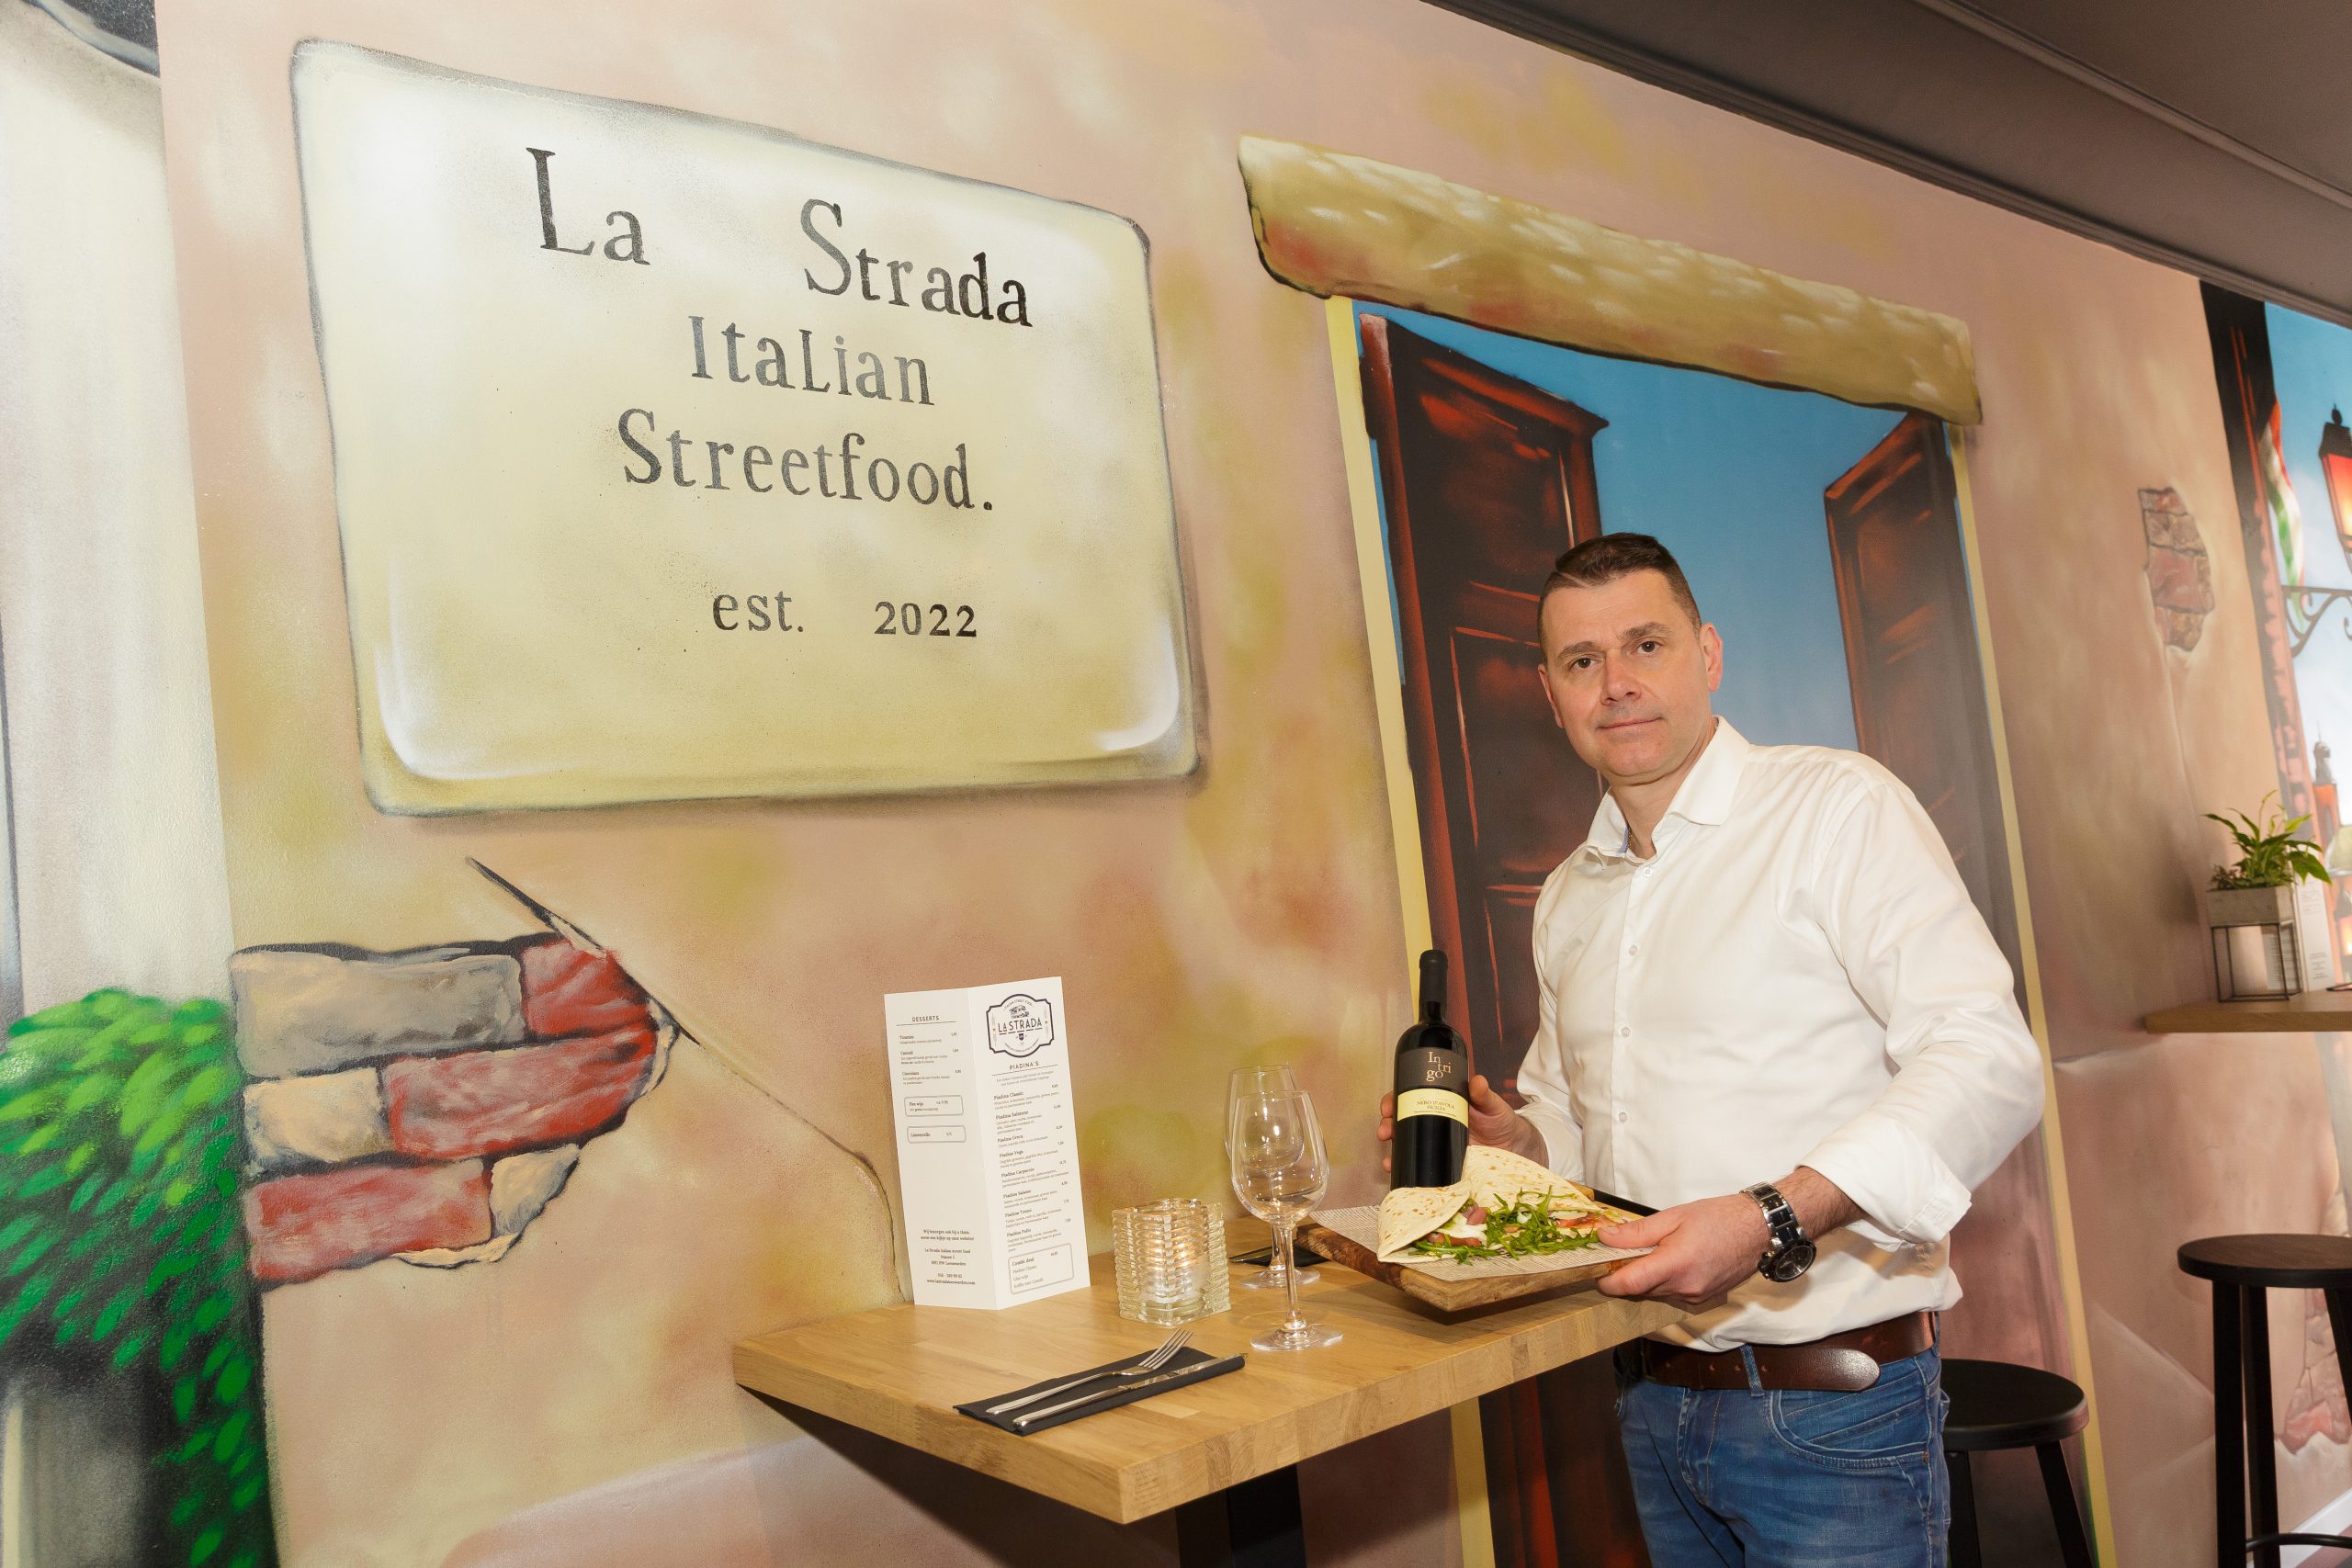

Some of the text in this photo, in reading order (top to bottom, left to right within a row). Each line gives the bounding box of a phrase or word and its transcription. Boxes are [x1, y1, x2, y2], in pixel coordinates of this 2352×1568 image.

[526, 147, 1034, 328] La Strada
[617, 408, 993, 512] Streetfood.
[712, 591, 978, 638] est. 2022
[998, 1017, 1042, 1032] LA STRADA
[1009, 1060, 1039, 1070] PIADINA'S
[1426, 1069, 1443, 1082] go
